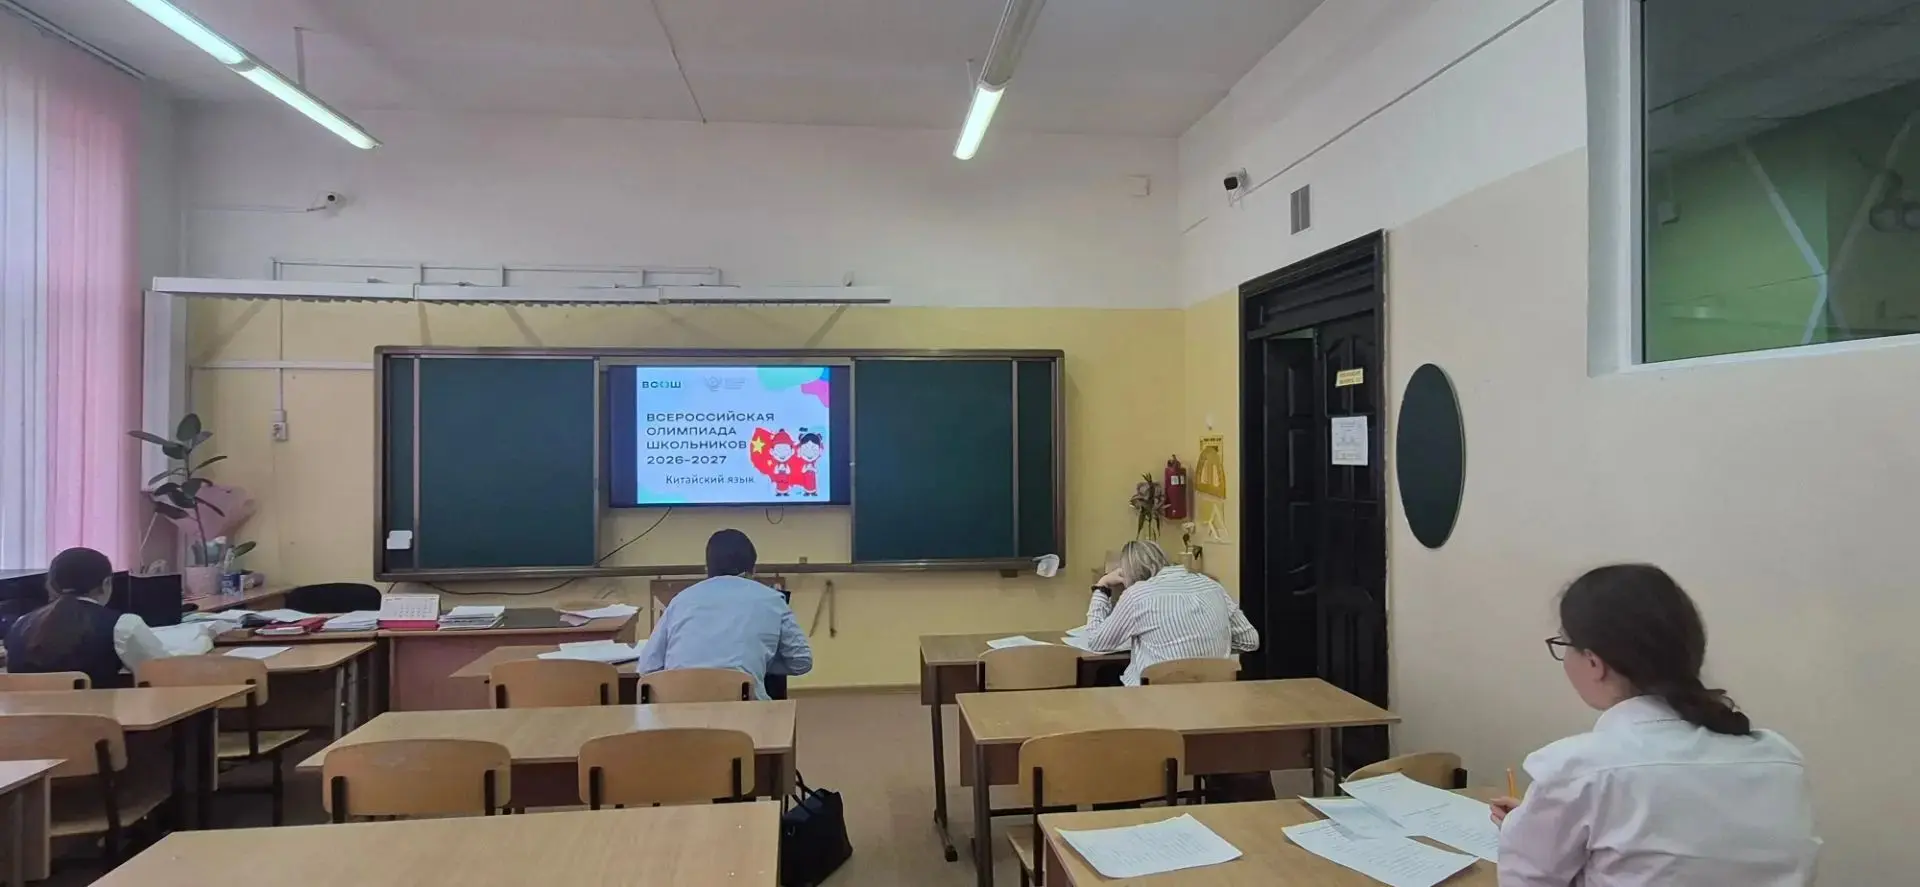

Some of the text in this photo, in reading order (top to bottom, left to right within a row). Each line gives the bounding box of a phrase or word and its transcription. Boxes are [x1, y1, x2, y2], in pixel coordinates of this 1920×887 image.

[646, 411, 775, 422] ВСЕРОССИЙСКАЯ
[646, 427, 737, 436] ОЛИМПИАДА
[646, 440, 747, 450] ШКОЛЬНИКОВ
[647, 455, 727, 465] 2026-2027
[666, 474, 755, 484] Китайский язык
